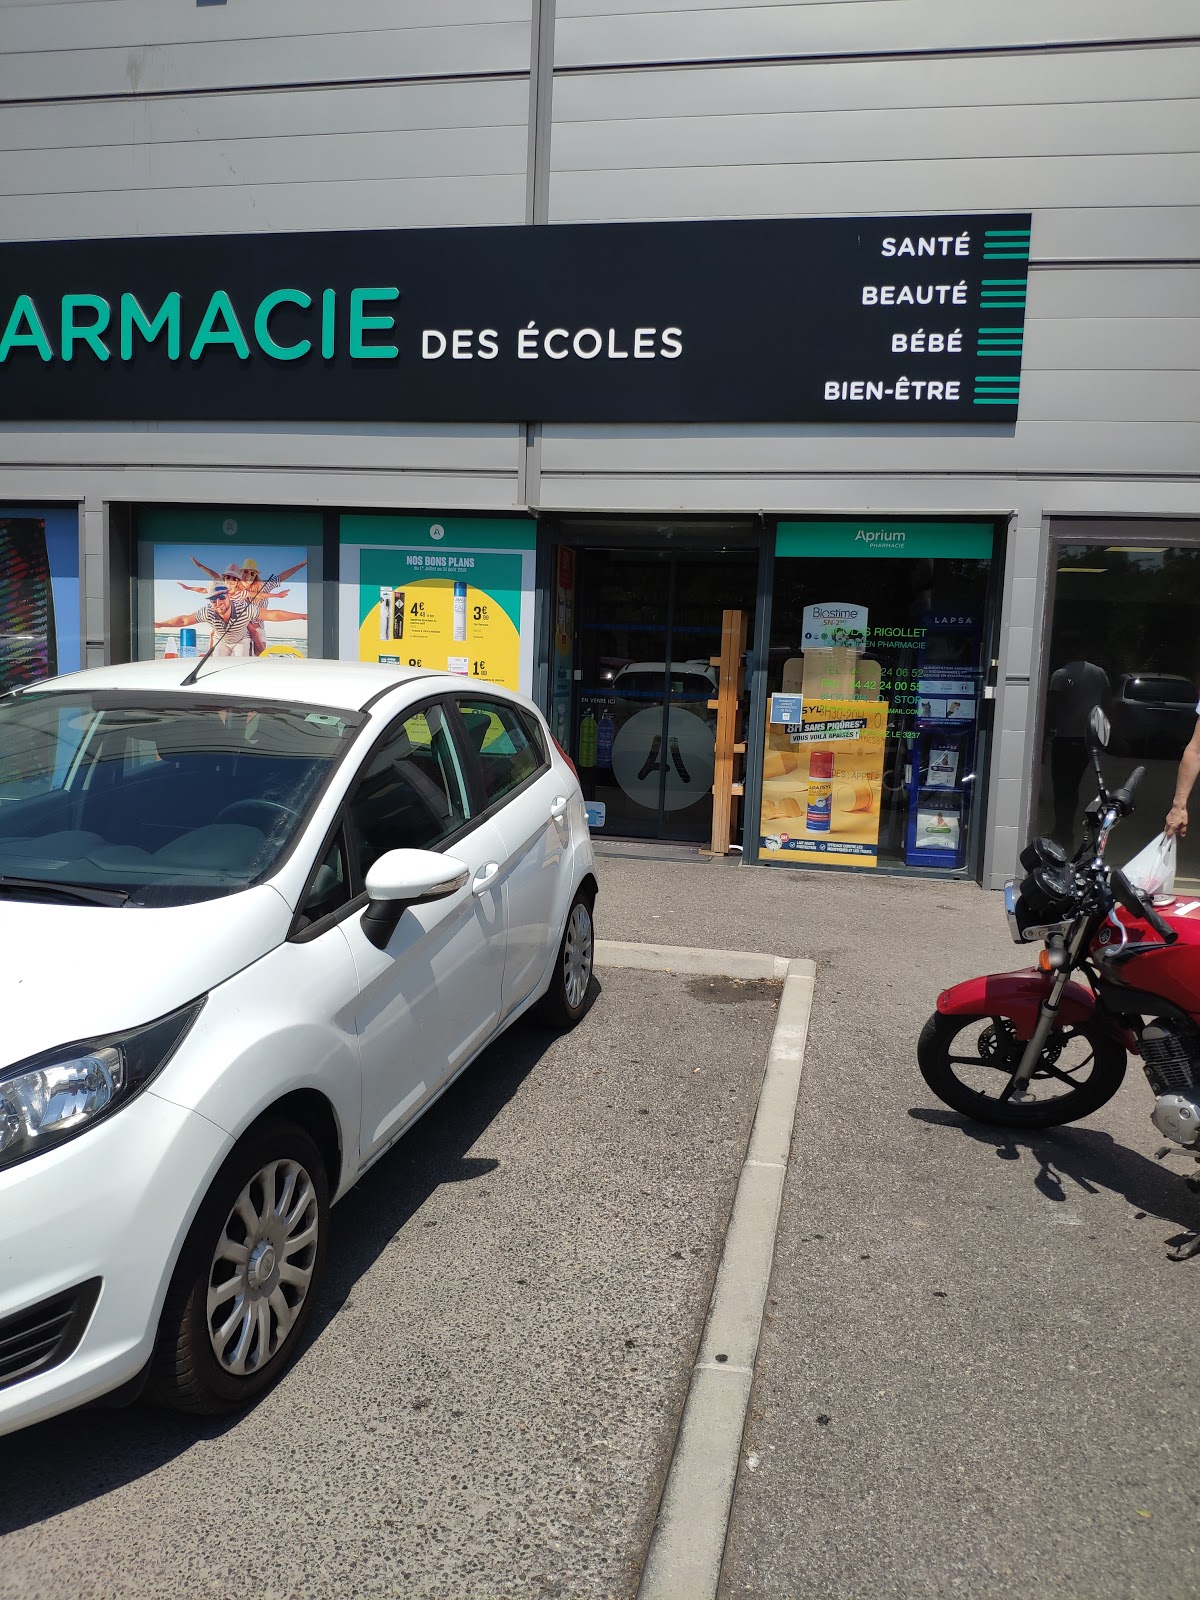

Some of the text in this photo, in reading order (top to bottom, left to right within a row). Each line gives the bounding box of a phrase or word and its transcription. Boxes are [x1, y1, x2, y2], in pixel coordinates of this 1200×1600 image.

[881, 231, 970, 256] SANTÉ
[862, 280, 968, 305] BEAUTÉ
[0, 287, 683, 363] ARMACIE DES ÉCOLES
[891, 328, 963, 352] BÉBÉ
[824, 375, 961, 400] BIEN-ÊTRE
[855, 530, 906, 543] Aprium
[406, 555, 475, 568] NOS BONS PLANS
[812, 607, 859, 618] Biostime
[934, 616, 973, 625] LAPSA
[824, 627, 928, 638] ICOLAS RIGOLLET
[878, 641, 926, 650] PHARMACIE
[881, 668, 893, 677] 24
[895, 668, 909, 678] 06
[911, 669, 924, 679] 52
[864, 681, 877, 691] 42
[879, 681, 892, 691] 24
[894, 681, 908, 692] 00
[909, 682, 923, 692] 55
[894, 694, 923, 705] STOP
[804, 723, 826, 732] SANS
[792, 734, 809, 742] VOUS
[903, 731, 921, 739] 3237
